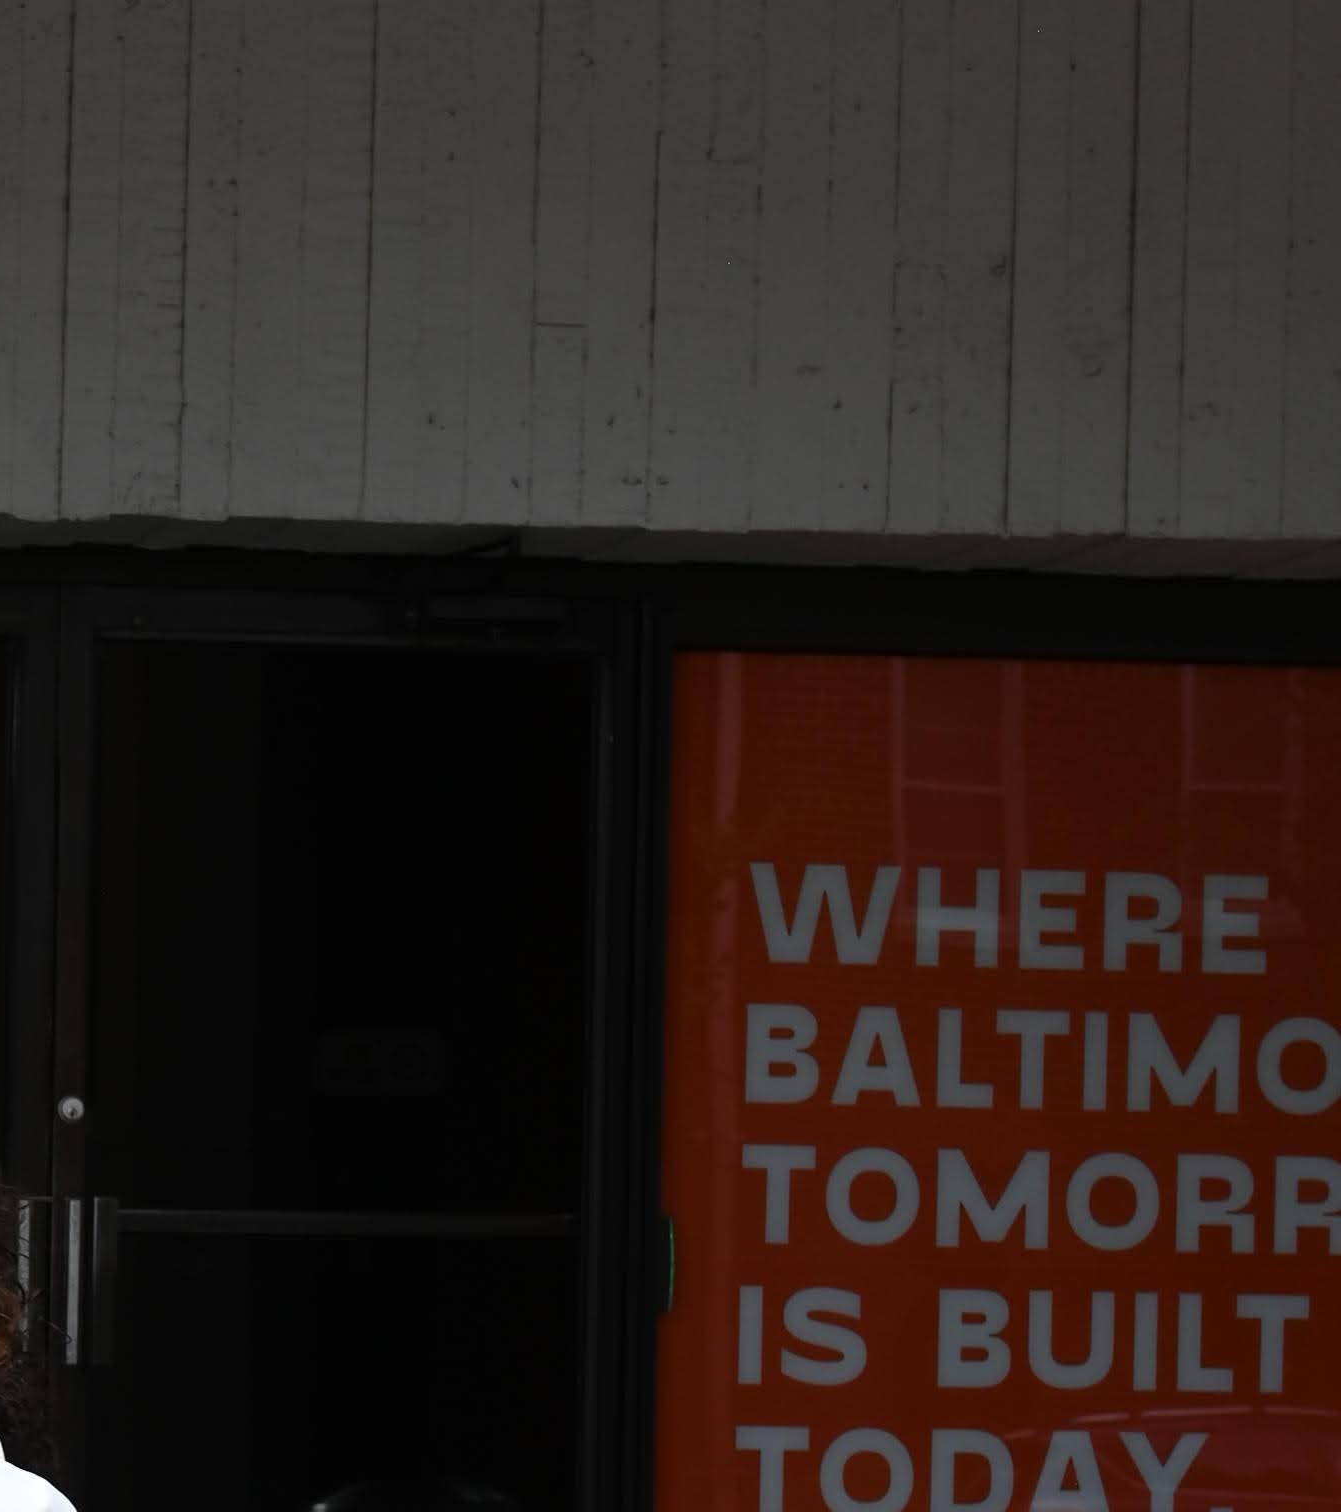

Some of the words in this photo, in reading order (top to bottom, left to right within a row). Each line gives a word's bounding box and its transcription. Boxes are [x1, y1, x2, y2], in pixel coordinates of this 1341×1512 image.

[750, 862, 1269, 974] WHERE
[744, 1002, 1341, 1114] BALTIMO
[741, 1143, 1341, 1255] TOMORR
[737, 1284, 868, 1386] IS
[937, 1289, 1309, 1393] BUILT
